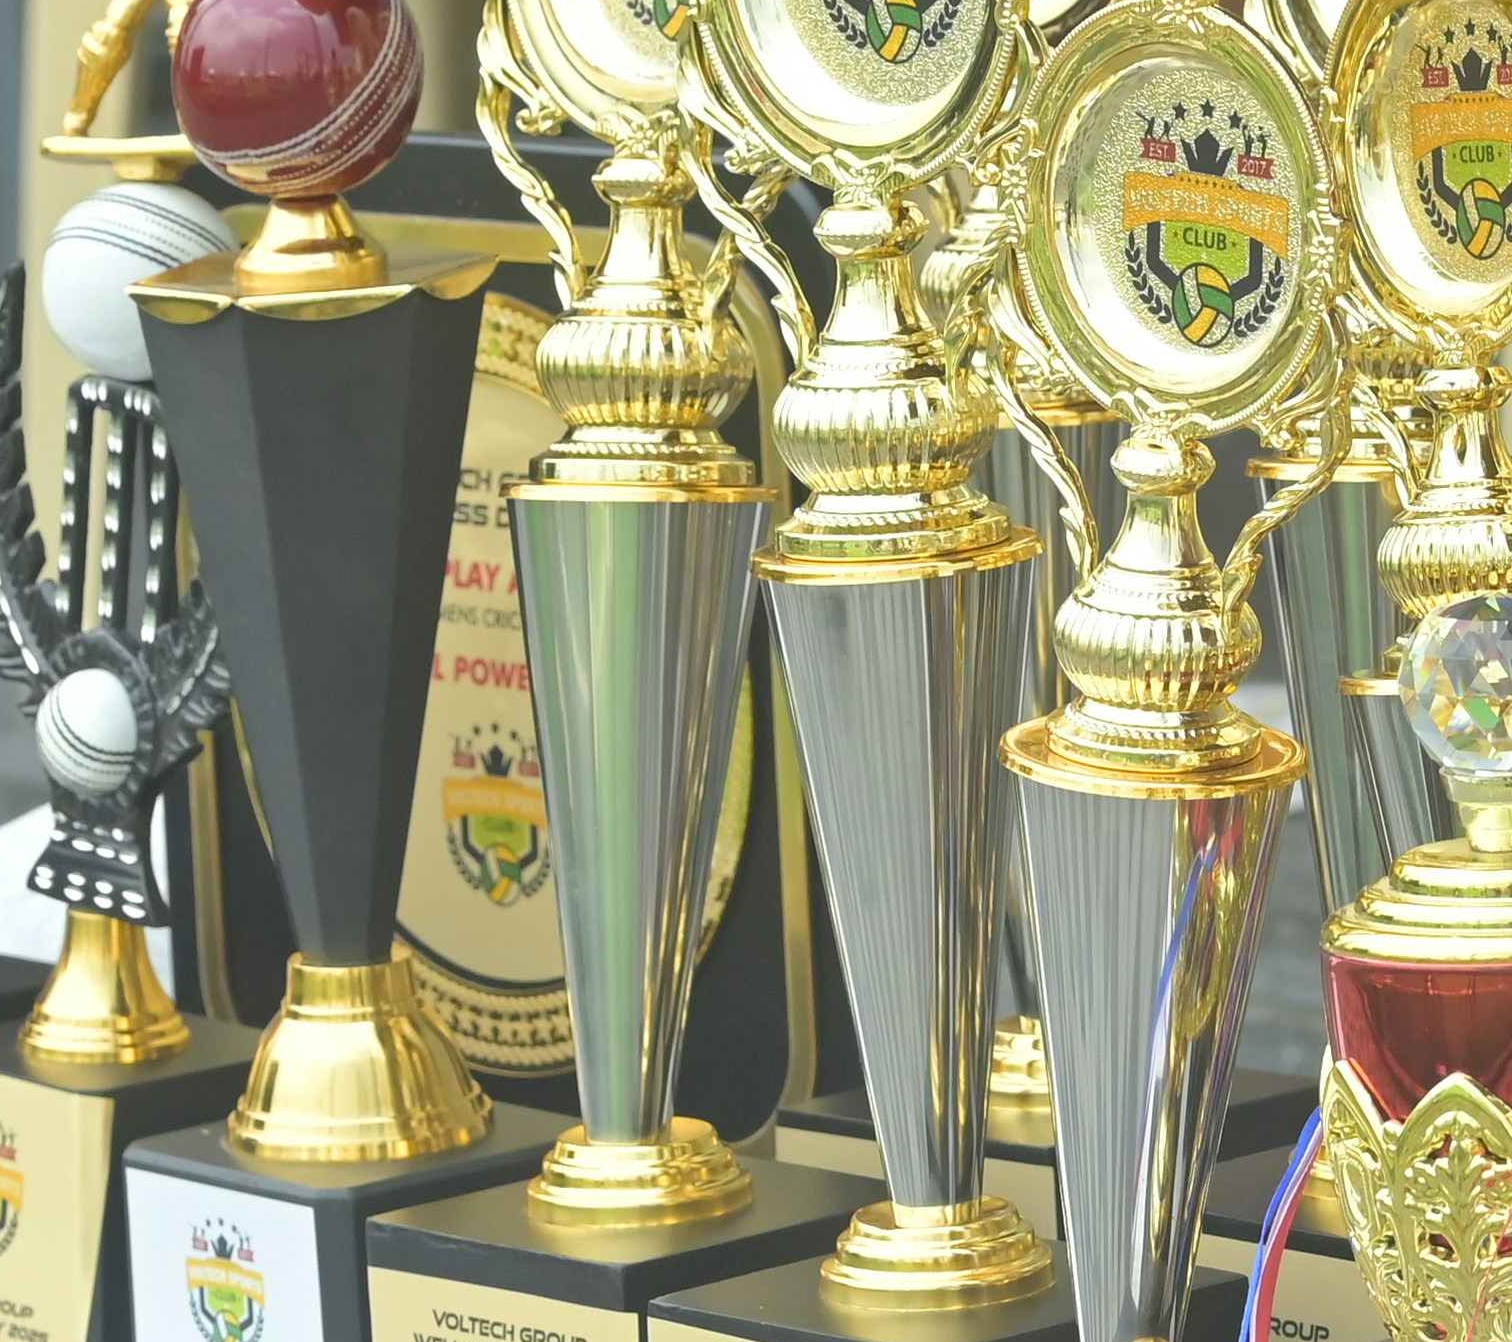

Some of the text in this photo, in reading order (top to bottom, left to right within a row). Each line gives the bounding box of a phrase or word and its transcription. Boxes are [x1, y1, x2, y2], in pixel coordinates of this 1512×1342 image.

[1147, 144, 1171, 159] EST.
[1459, 145, 1495, 163] CLUB
[1241, 160, 1267, 174] 2017
[1182, 227, 1228, 251] CLUB
[432, 1308, 515, 1341] VOLTECH
